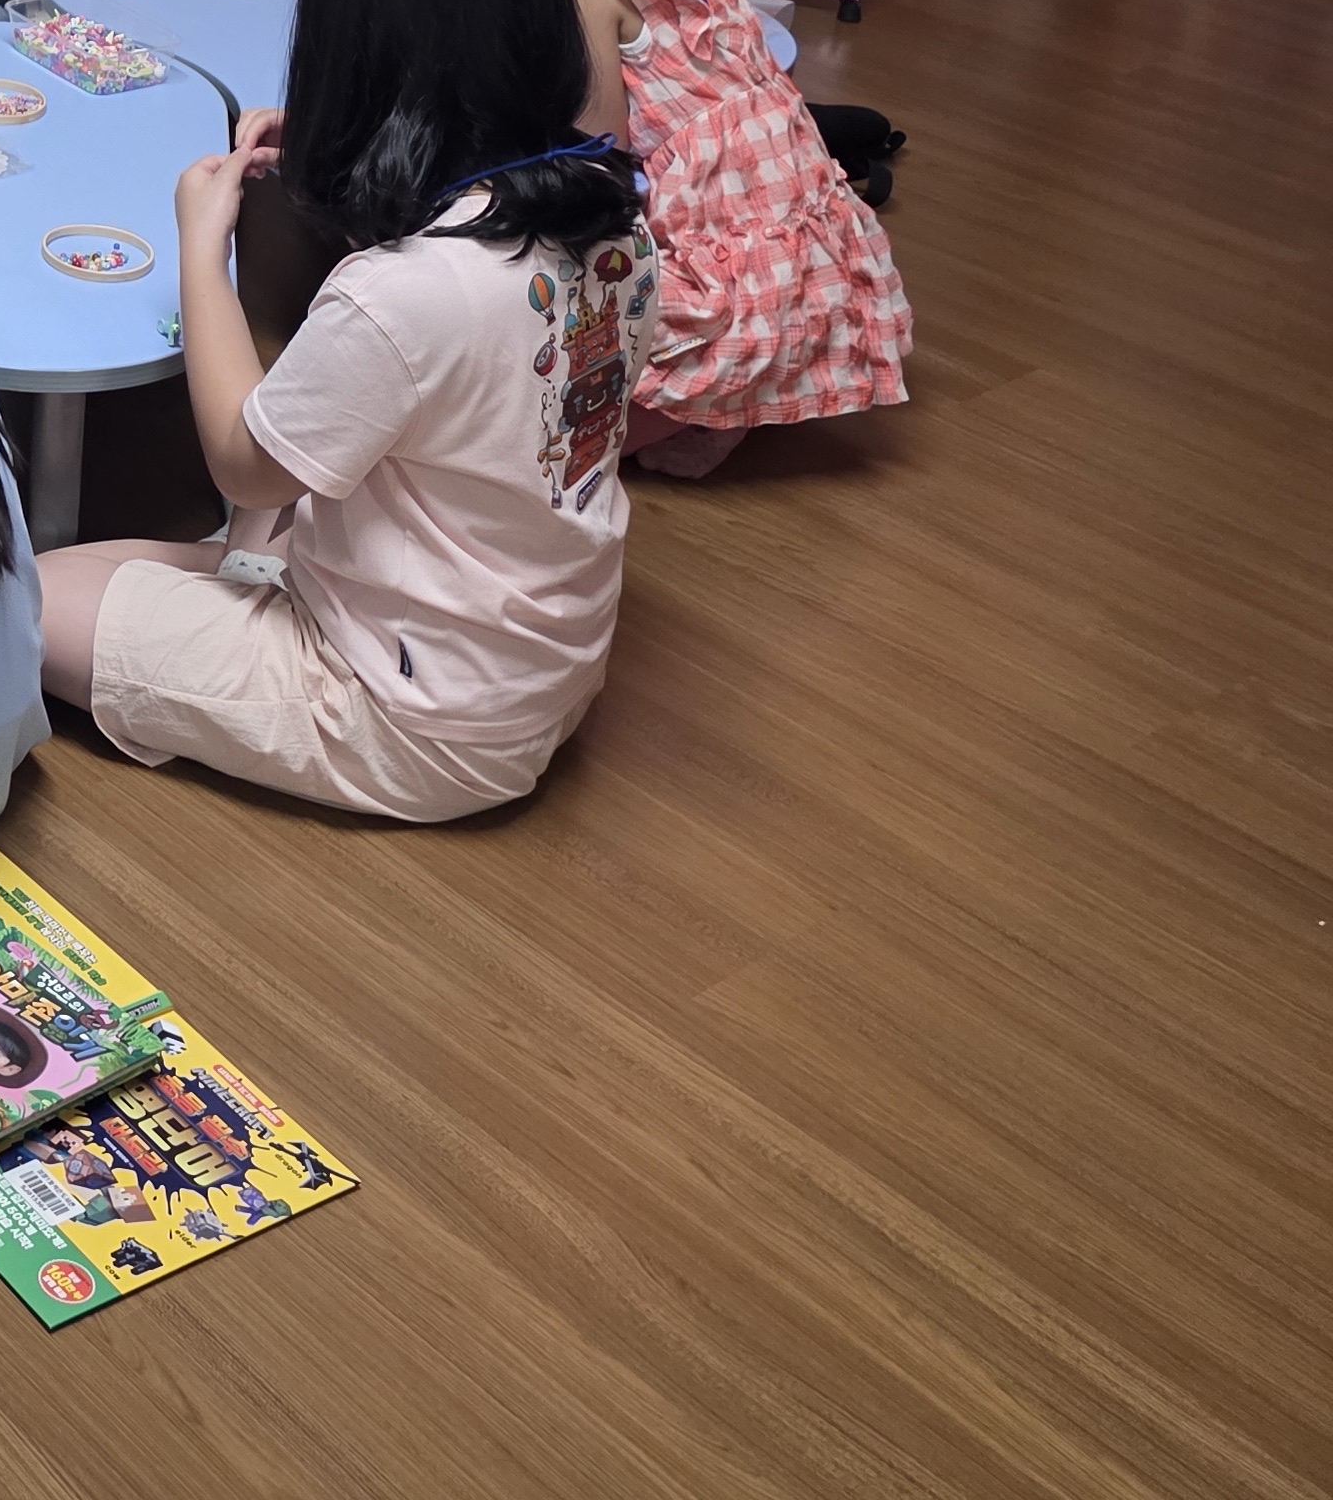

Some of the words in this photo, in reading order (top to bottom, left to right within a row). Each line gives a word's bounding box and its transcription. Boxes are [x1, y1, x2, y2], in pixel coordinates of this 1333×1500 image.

[36, 971, 85, 1013] 정브르의
[189, 1065, 275, 1140] MINECRAFT
[257, 1105, 280, 1124] BOOK
[103, 1076, 236, 1187] 영단어
[273, 1153, 303, 1179] dragon
[4, 1205, 38, 1235] 500개
[7, 1226, 35, 1250] 시작!
[173, 1229, 198, 1249] elder
[103, 1265, 121, 1280] cow
